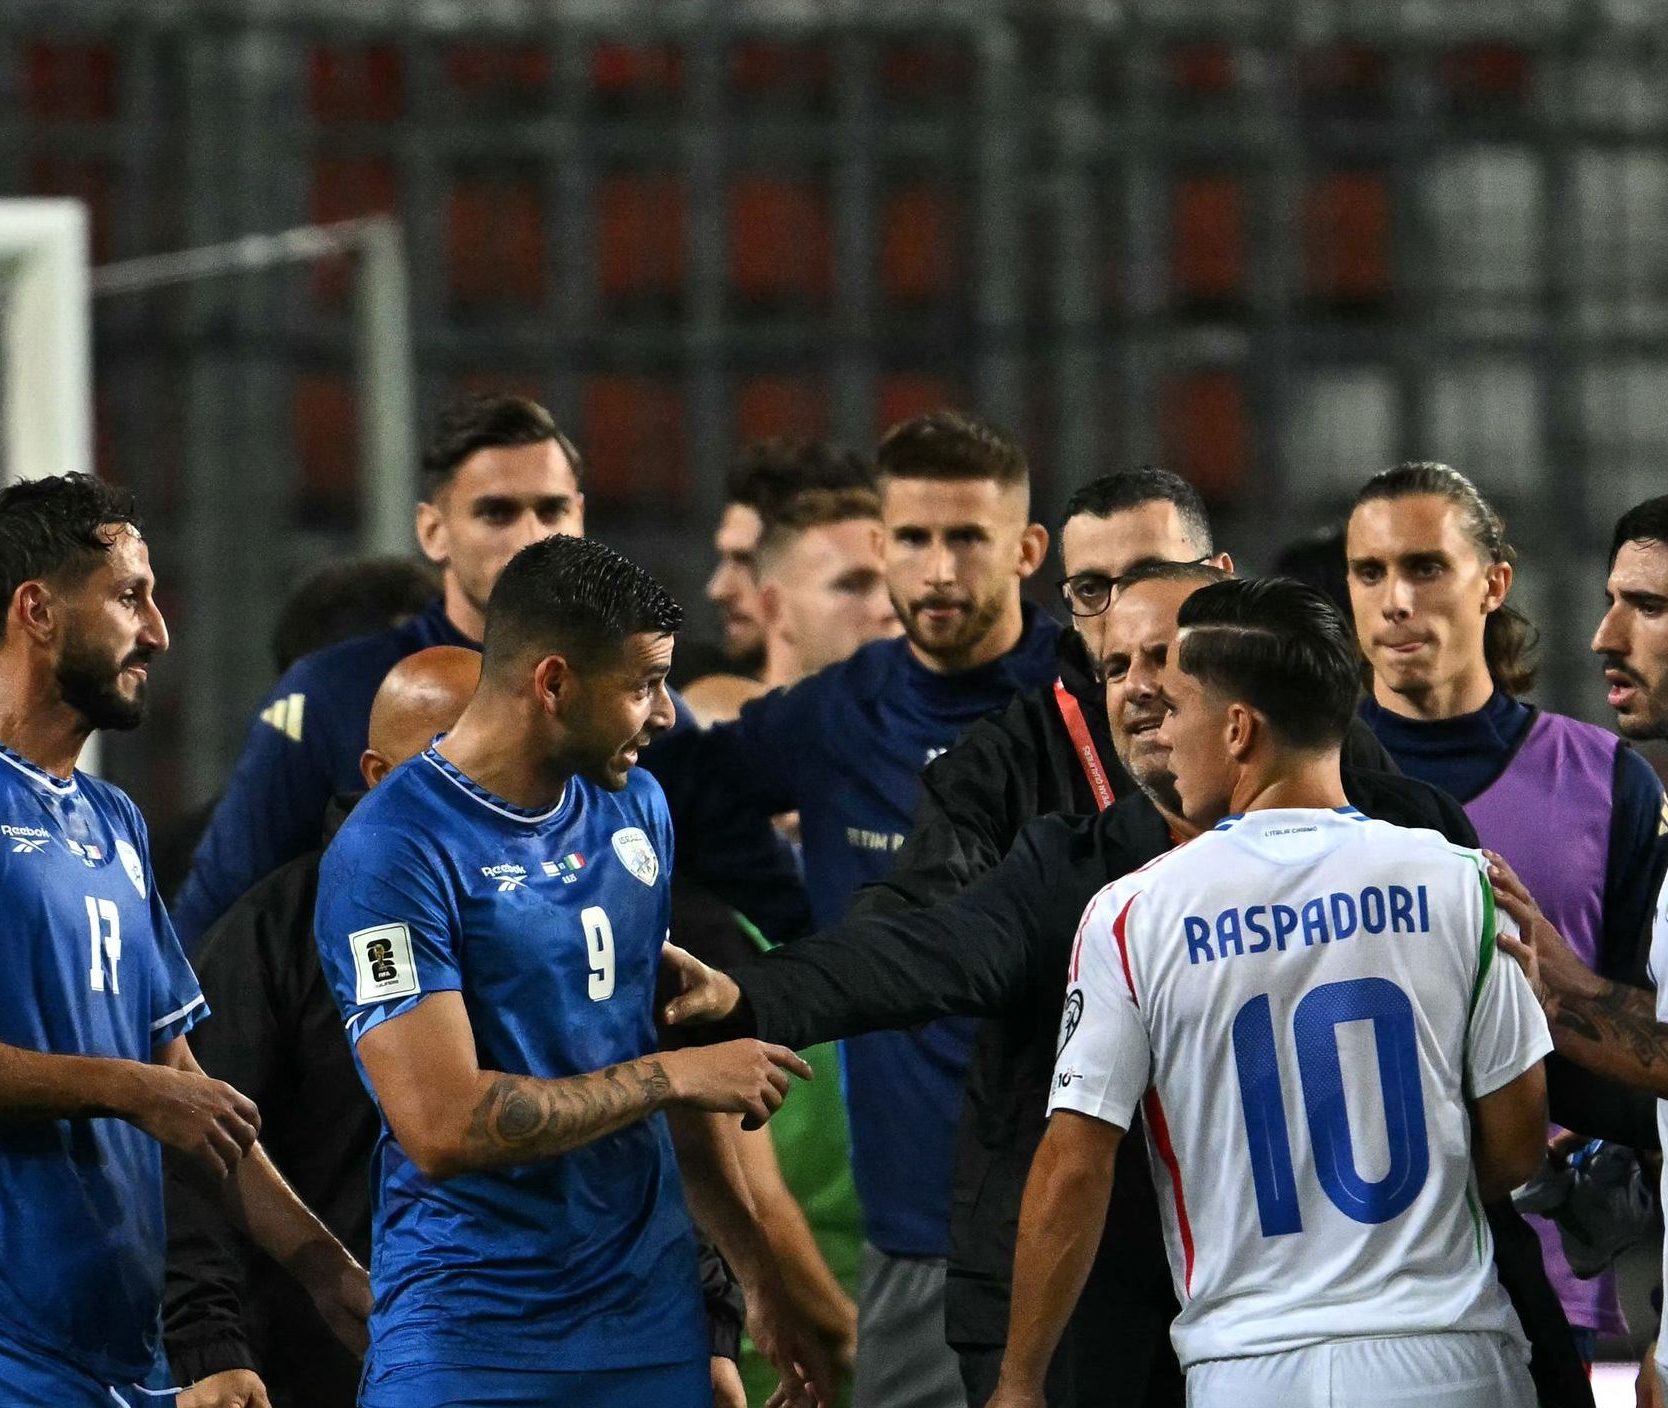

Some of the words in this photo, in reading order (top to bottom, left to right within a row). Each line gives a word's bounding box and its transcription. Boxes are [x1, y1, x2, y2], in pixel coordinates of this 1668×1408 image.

[1, 825, 50, 837] Reebok
[481, 863, 526, 877] Reebok
[581, 906, 615, 1001] 9
[1184, 885, 1430, 964] RASPADORI
[1232, 977, 1429, 1237] 10
